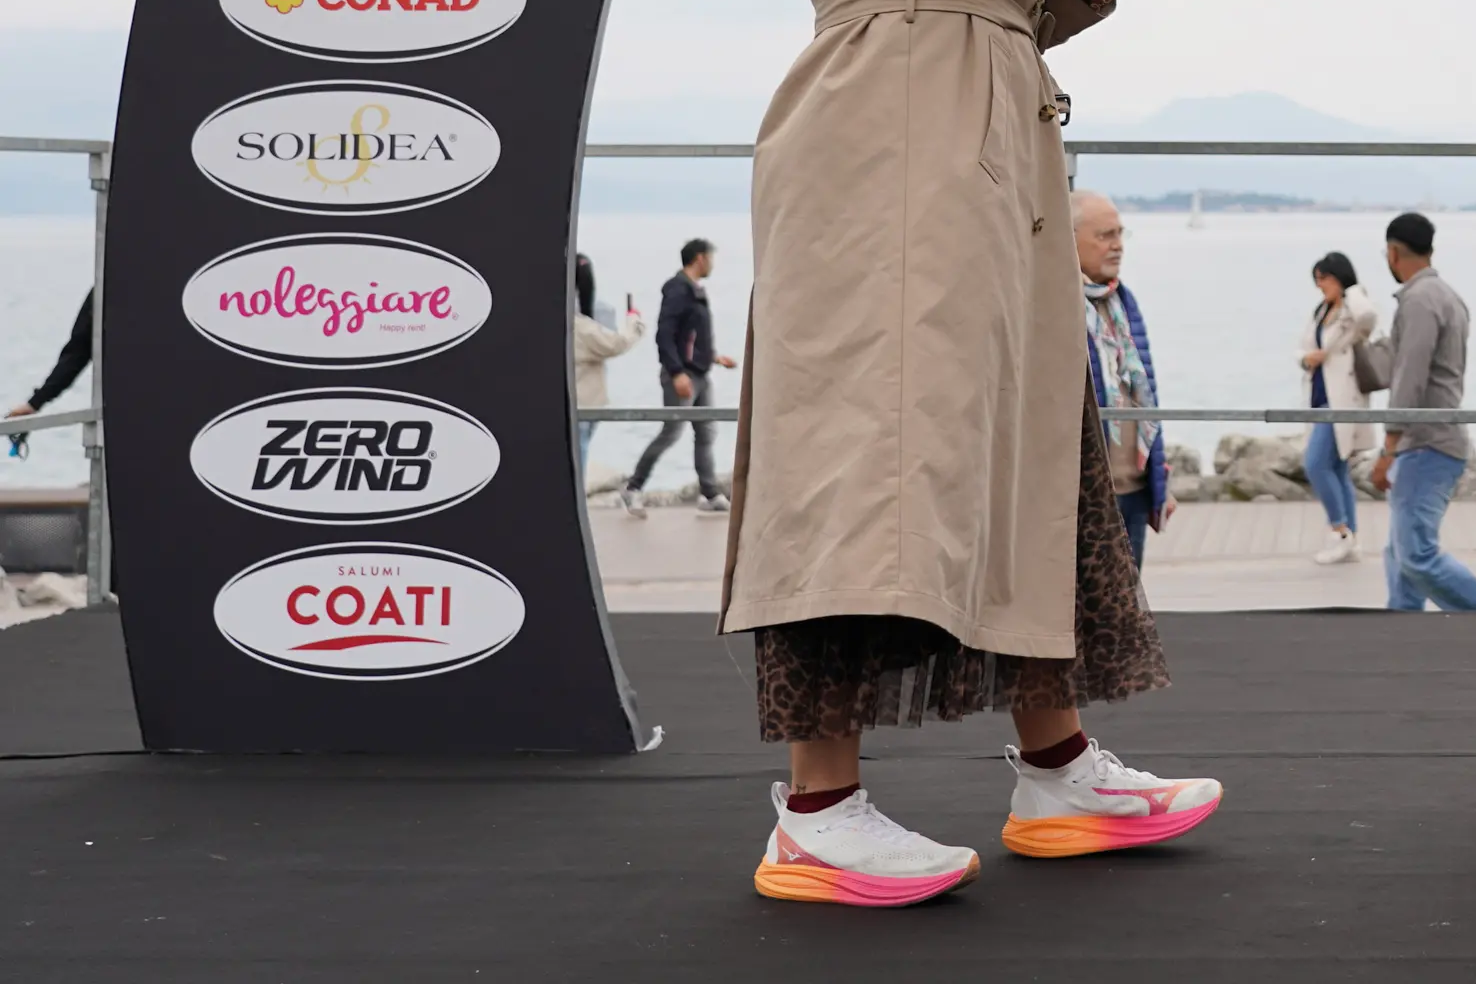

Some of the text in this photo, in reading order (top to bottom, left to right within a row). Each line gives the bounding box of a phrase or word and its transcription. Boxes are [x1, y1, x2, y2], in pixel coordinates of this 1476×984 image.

[219, 266, 452, 337] noleggiare
[379, 323, 405, 333] Happy
[259, 419, 433, 457] ZERO
[251, 457, 432, 492] WIND
[338, 566, 401, 577] SALUMI
[286, 584, 451, 626] COATI
